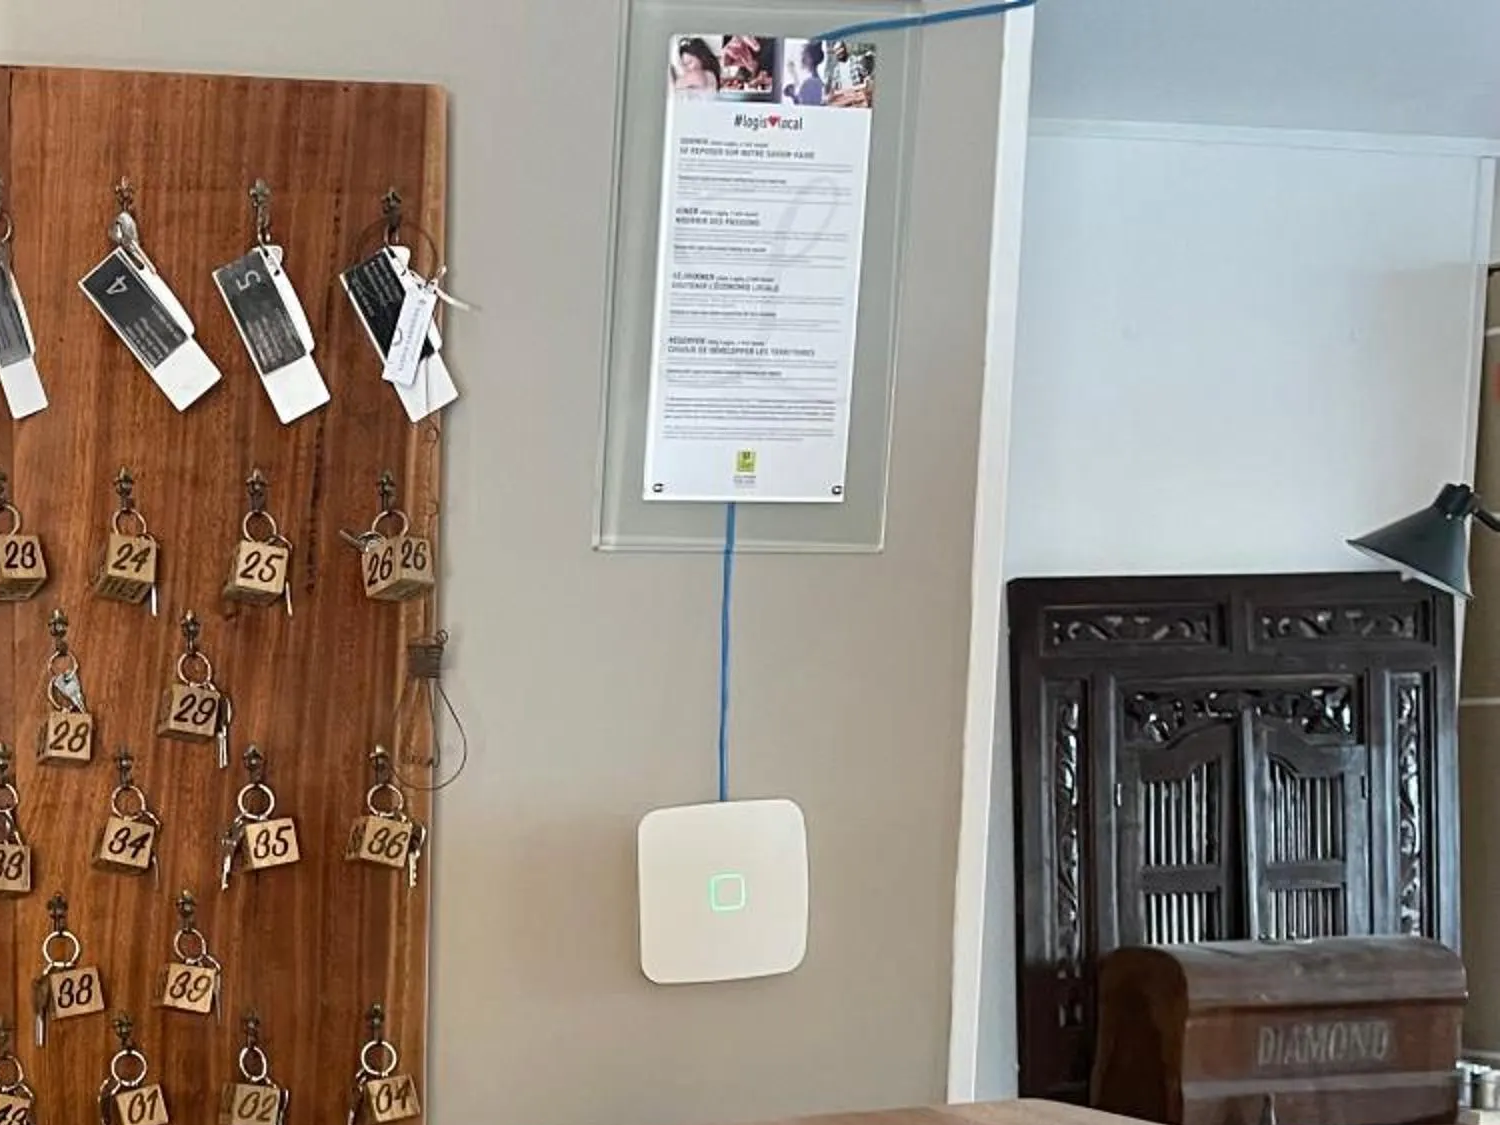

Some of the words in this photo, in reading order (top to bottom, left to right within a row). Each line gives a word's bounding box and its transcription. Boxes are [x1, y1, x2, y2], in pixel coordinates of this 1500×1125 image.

[104, 274, 130, 297] 4
[235, 269, 262, 292] 5
[111, 544, 151, 574] 24
[239, 550, 284, 583] 25
[366, 546, 393, 587] 26
[400, 539, 427, 571] 26
[173, 693, 217, 727] 29
[50, 720, 90, 753] 28
[1256, 1019, 1390, 1067] DIAMOND
